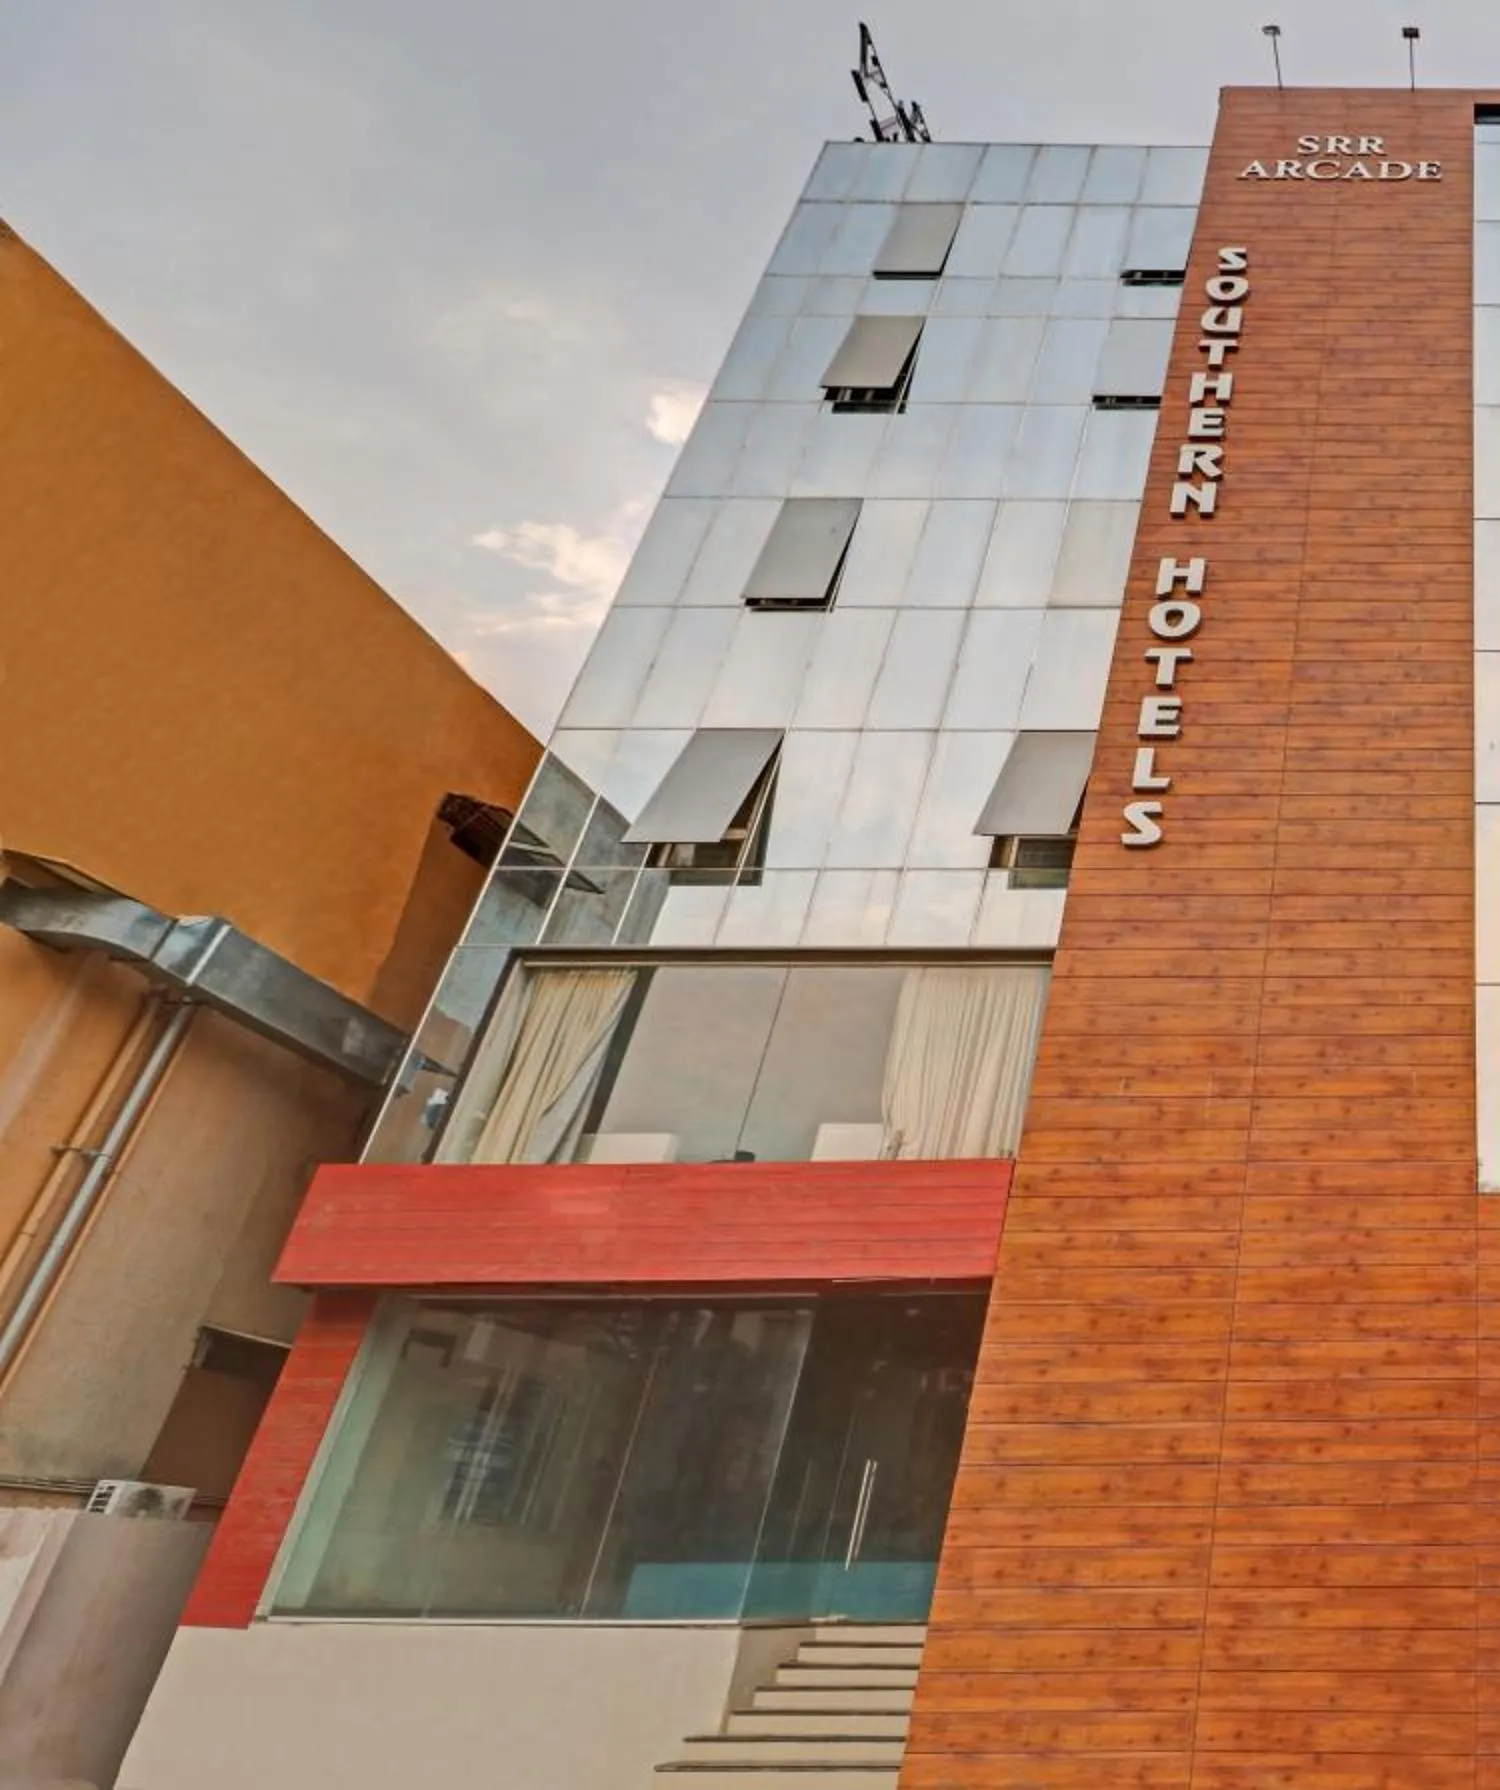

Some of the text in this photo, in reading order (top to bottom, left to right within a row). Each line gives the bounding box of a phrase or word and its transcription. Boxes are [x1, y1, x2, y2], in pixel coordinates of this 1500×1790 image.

[1238, 160, 1444, 182] ARCADE
[1297, 135, 1387, 155] SRR
[1169, 247, 1250, 518] SOUTHERN
[1121, 557, 1206, 848] HOTELS
